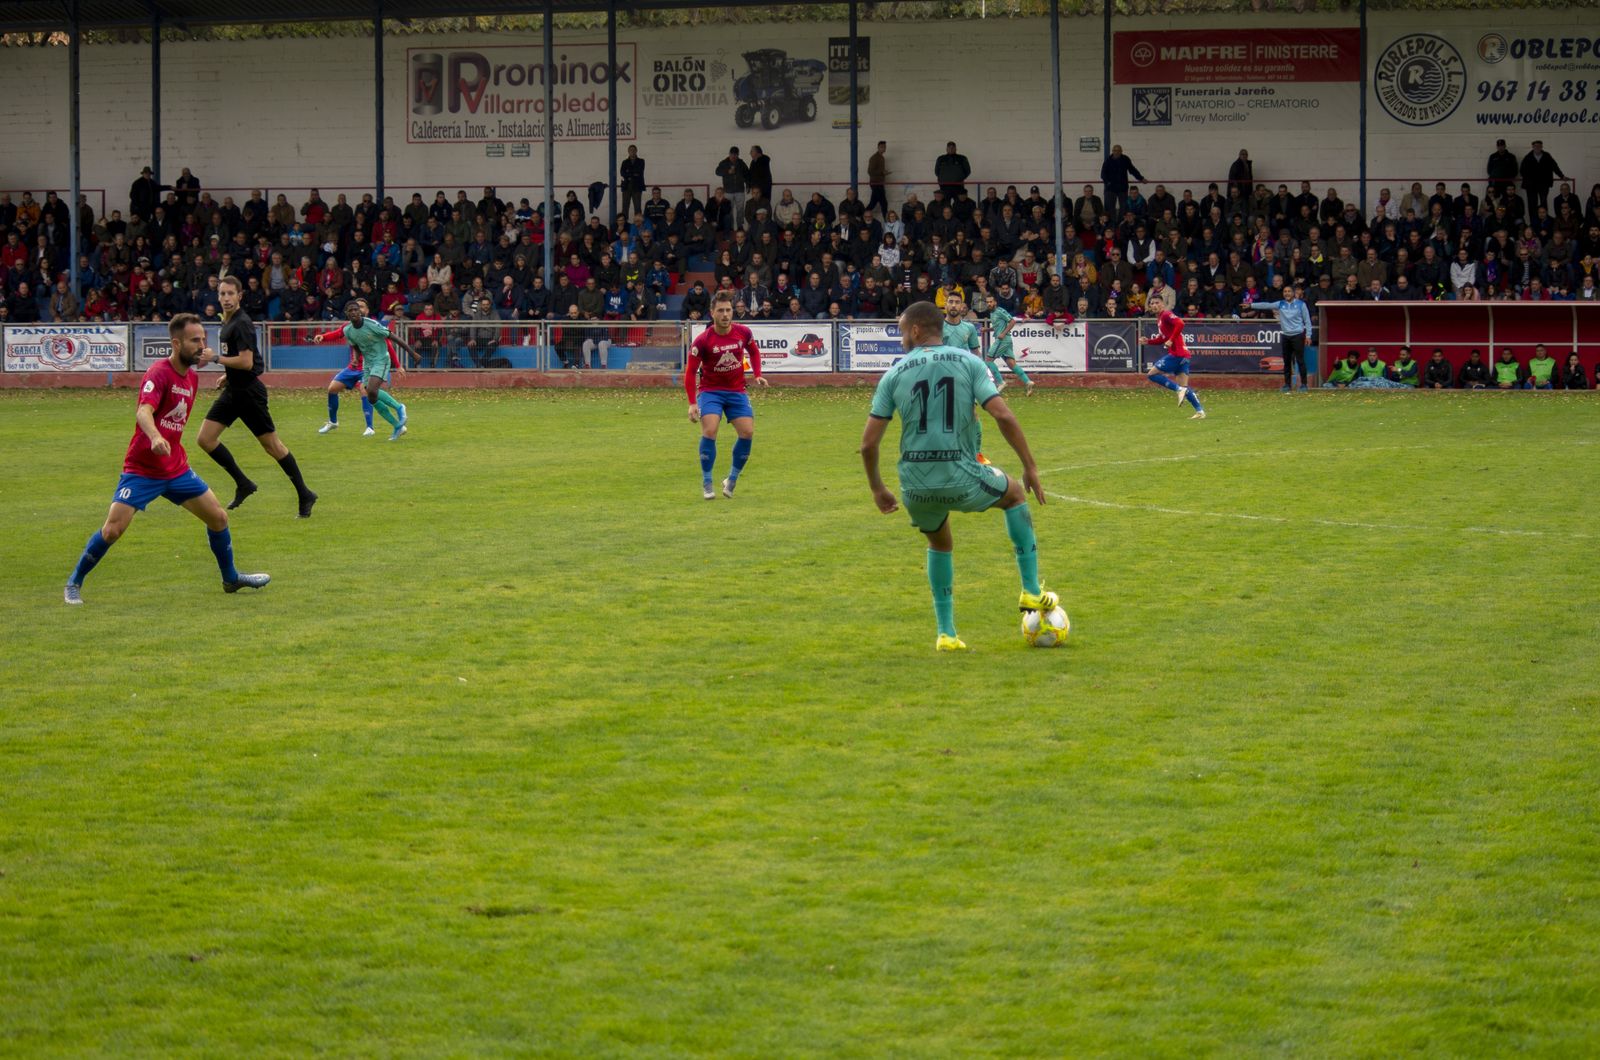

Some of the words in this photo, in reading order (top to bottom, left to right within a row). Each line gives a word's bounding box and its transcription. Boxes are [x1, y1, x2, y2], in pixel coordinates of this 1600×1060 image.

[1160, 46, 1248, 61] MAPFRE
[1256, 45, 1339, 60] FINISTERRE
[1184, 64, 1213, 73] Nuestra
[1215, 63, 1241, 72] solidez
[1264, 63, 1296, 74] garantía
[653, 73, 706, 93] ORO
[1174, 86, 1231, 97] Funeraria
[1234, 86, 1276, 96] Jareño
[1477, 80, 1519, 103] 967
[1527, 80, 1551, 102] 14
[1559, 80, 1588, 102] 38
[642, 93, 730, 107] VENDIMIA
[1175, 99, 1236, 109] TANATORIO
[1247, 98, 1320, 109] CREMATORIO
[1418, 107, 1430, 121] EN
[412, 120, 461, 140] Calderería
[464, 119, 489, 139] Inox.
[498, 118, 564, 139] Instalacioes
[566, 117, 632, 138] Alimentaias
[1010, 327, 1059, 340] odiesel,
[1062, 328, 1085, 338] S.L.
[752, 339, 788, 350] ALERO
[856, 343, 879, 352] AUDING
[1096, 347, 1128, 356] MAN
[911, 376, 955, 435] 11
[119, 487, 132, 500] 10
